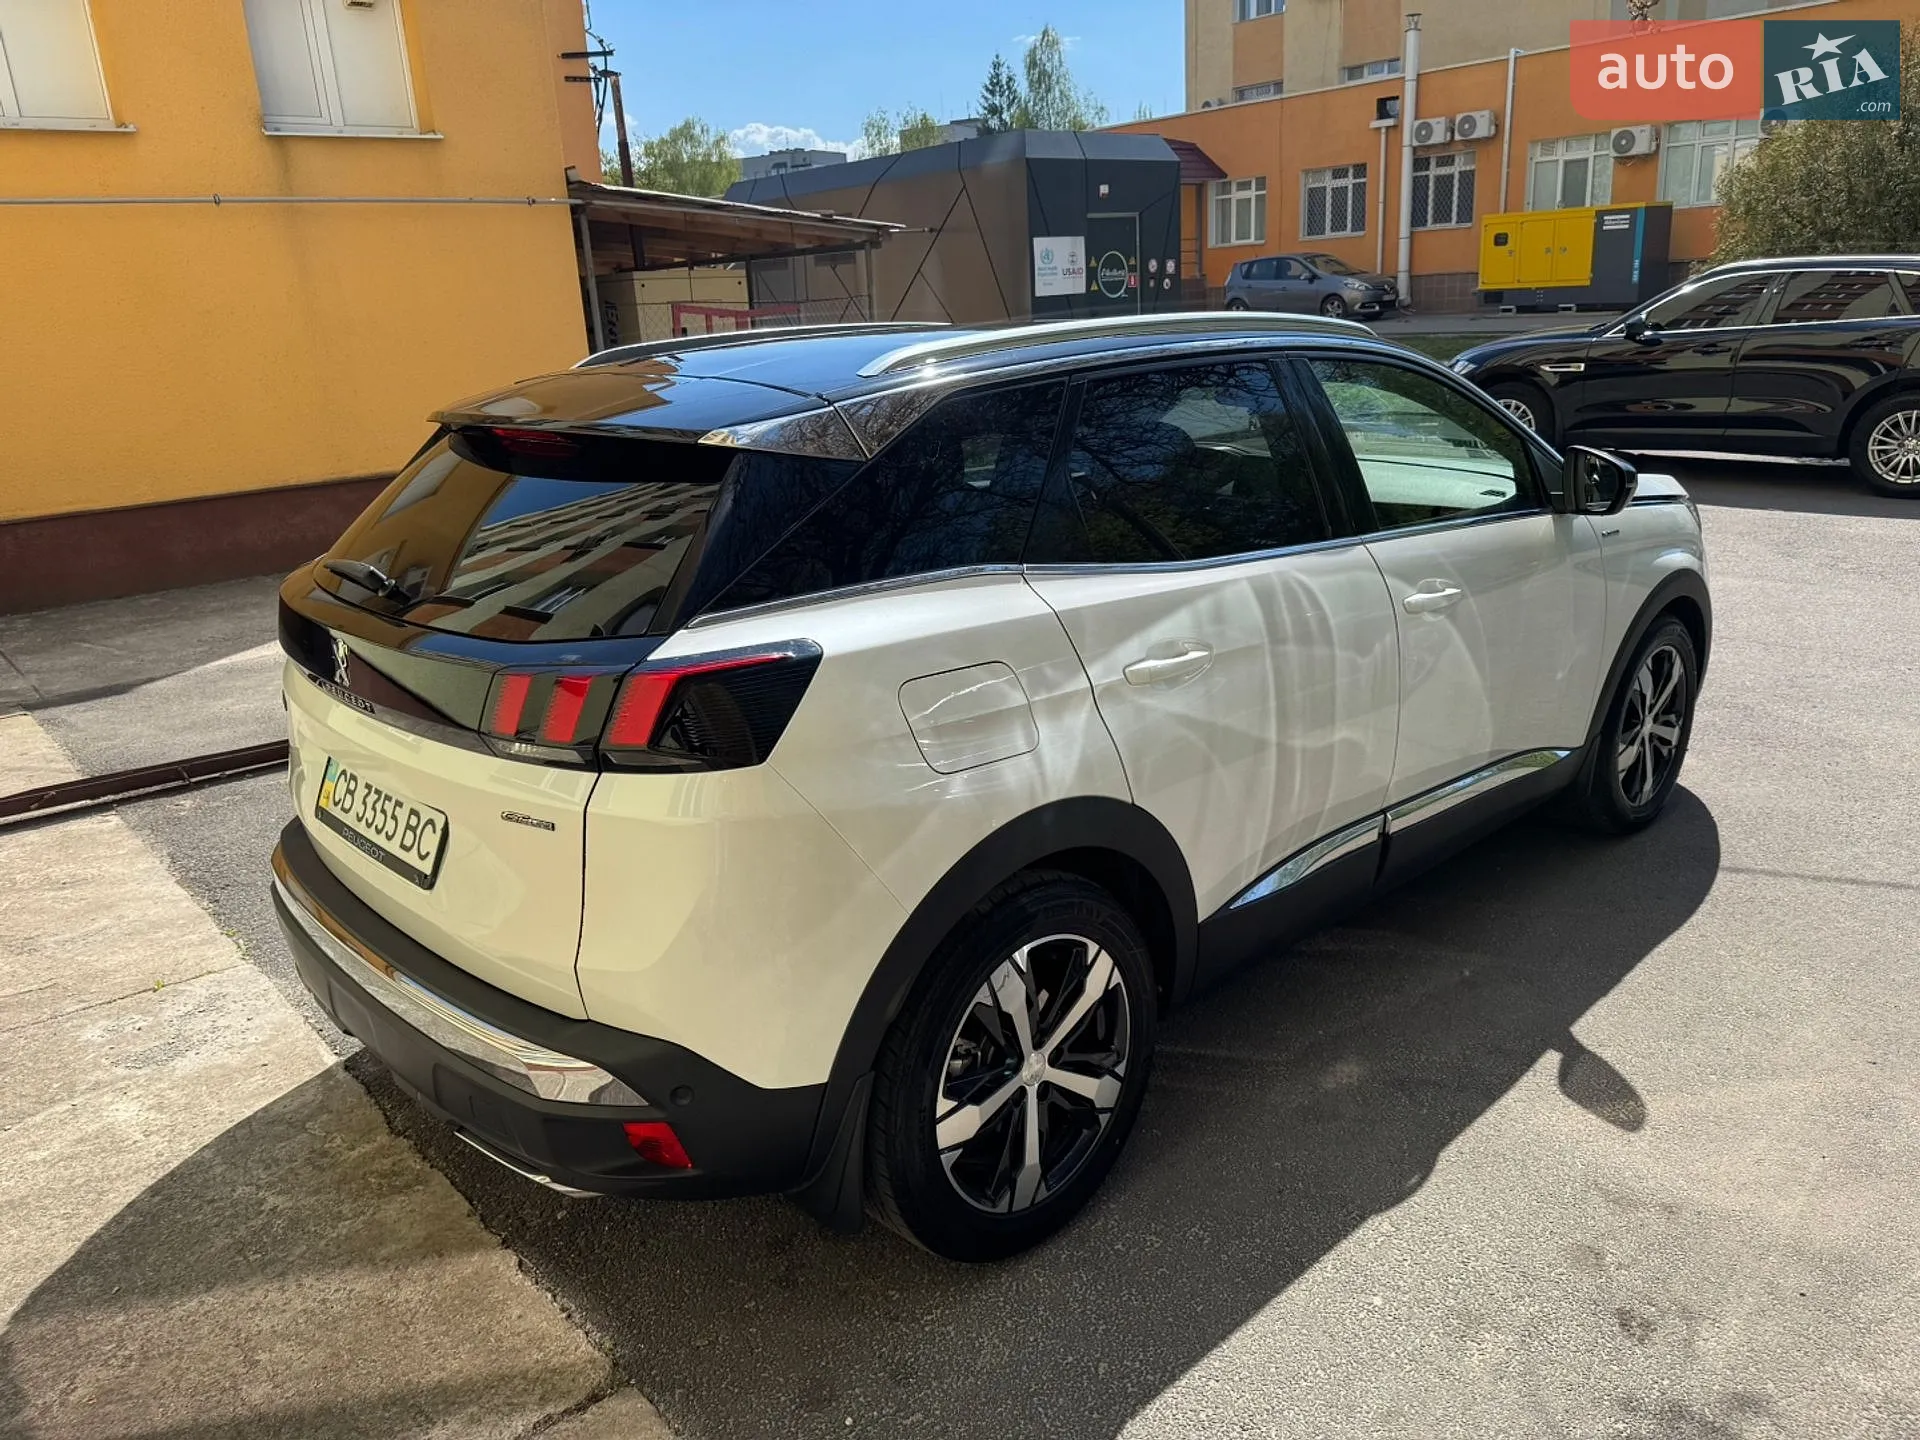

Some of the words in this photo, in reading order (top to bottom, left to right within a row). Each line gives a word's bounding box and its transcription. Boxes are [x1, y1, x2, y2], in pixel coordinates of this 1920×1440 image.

[1062, 267, 1084, 276] USAID
[333, 768, 358, 815] CB
[356, 782, 403, 842] 3355
[399, 808, 437, 861] BC
[342, 827, 386, 862] PEUGEOT
